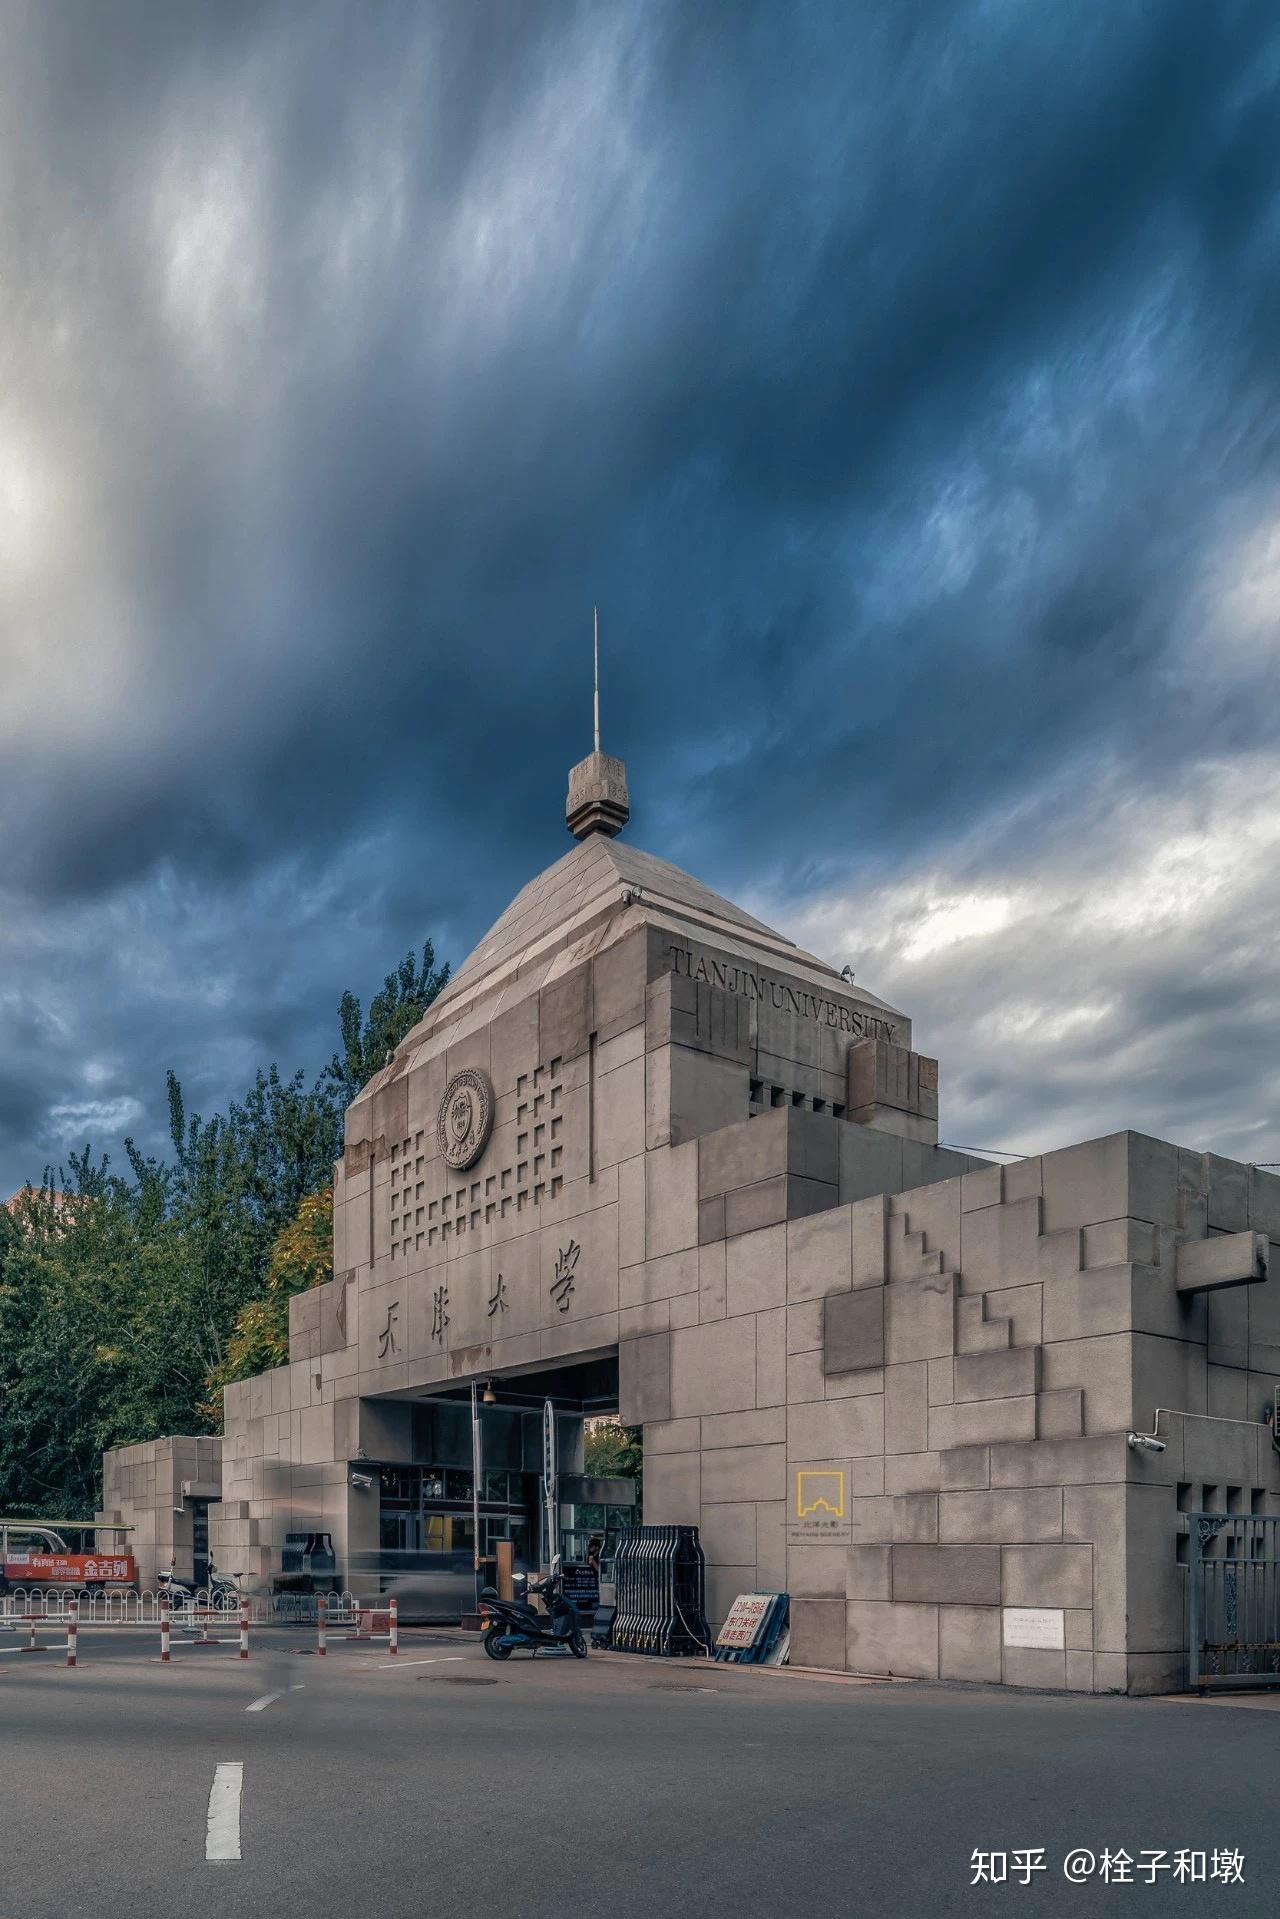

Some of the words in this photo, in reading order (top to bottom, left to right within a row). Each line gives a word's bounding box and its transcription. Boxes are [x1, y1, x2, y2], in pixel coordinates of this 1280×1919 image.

[670, 945, 766, 1001] TIANJIN
[768, 981, 896, 1044] UNIVERSITY
[83, 1560, 129, 1577] 金吉列
